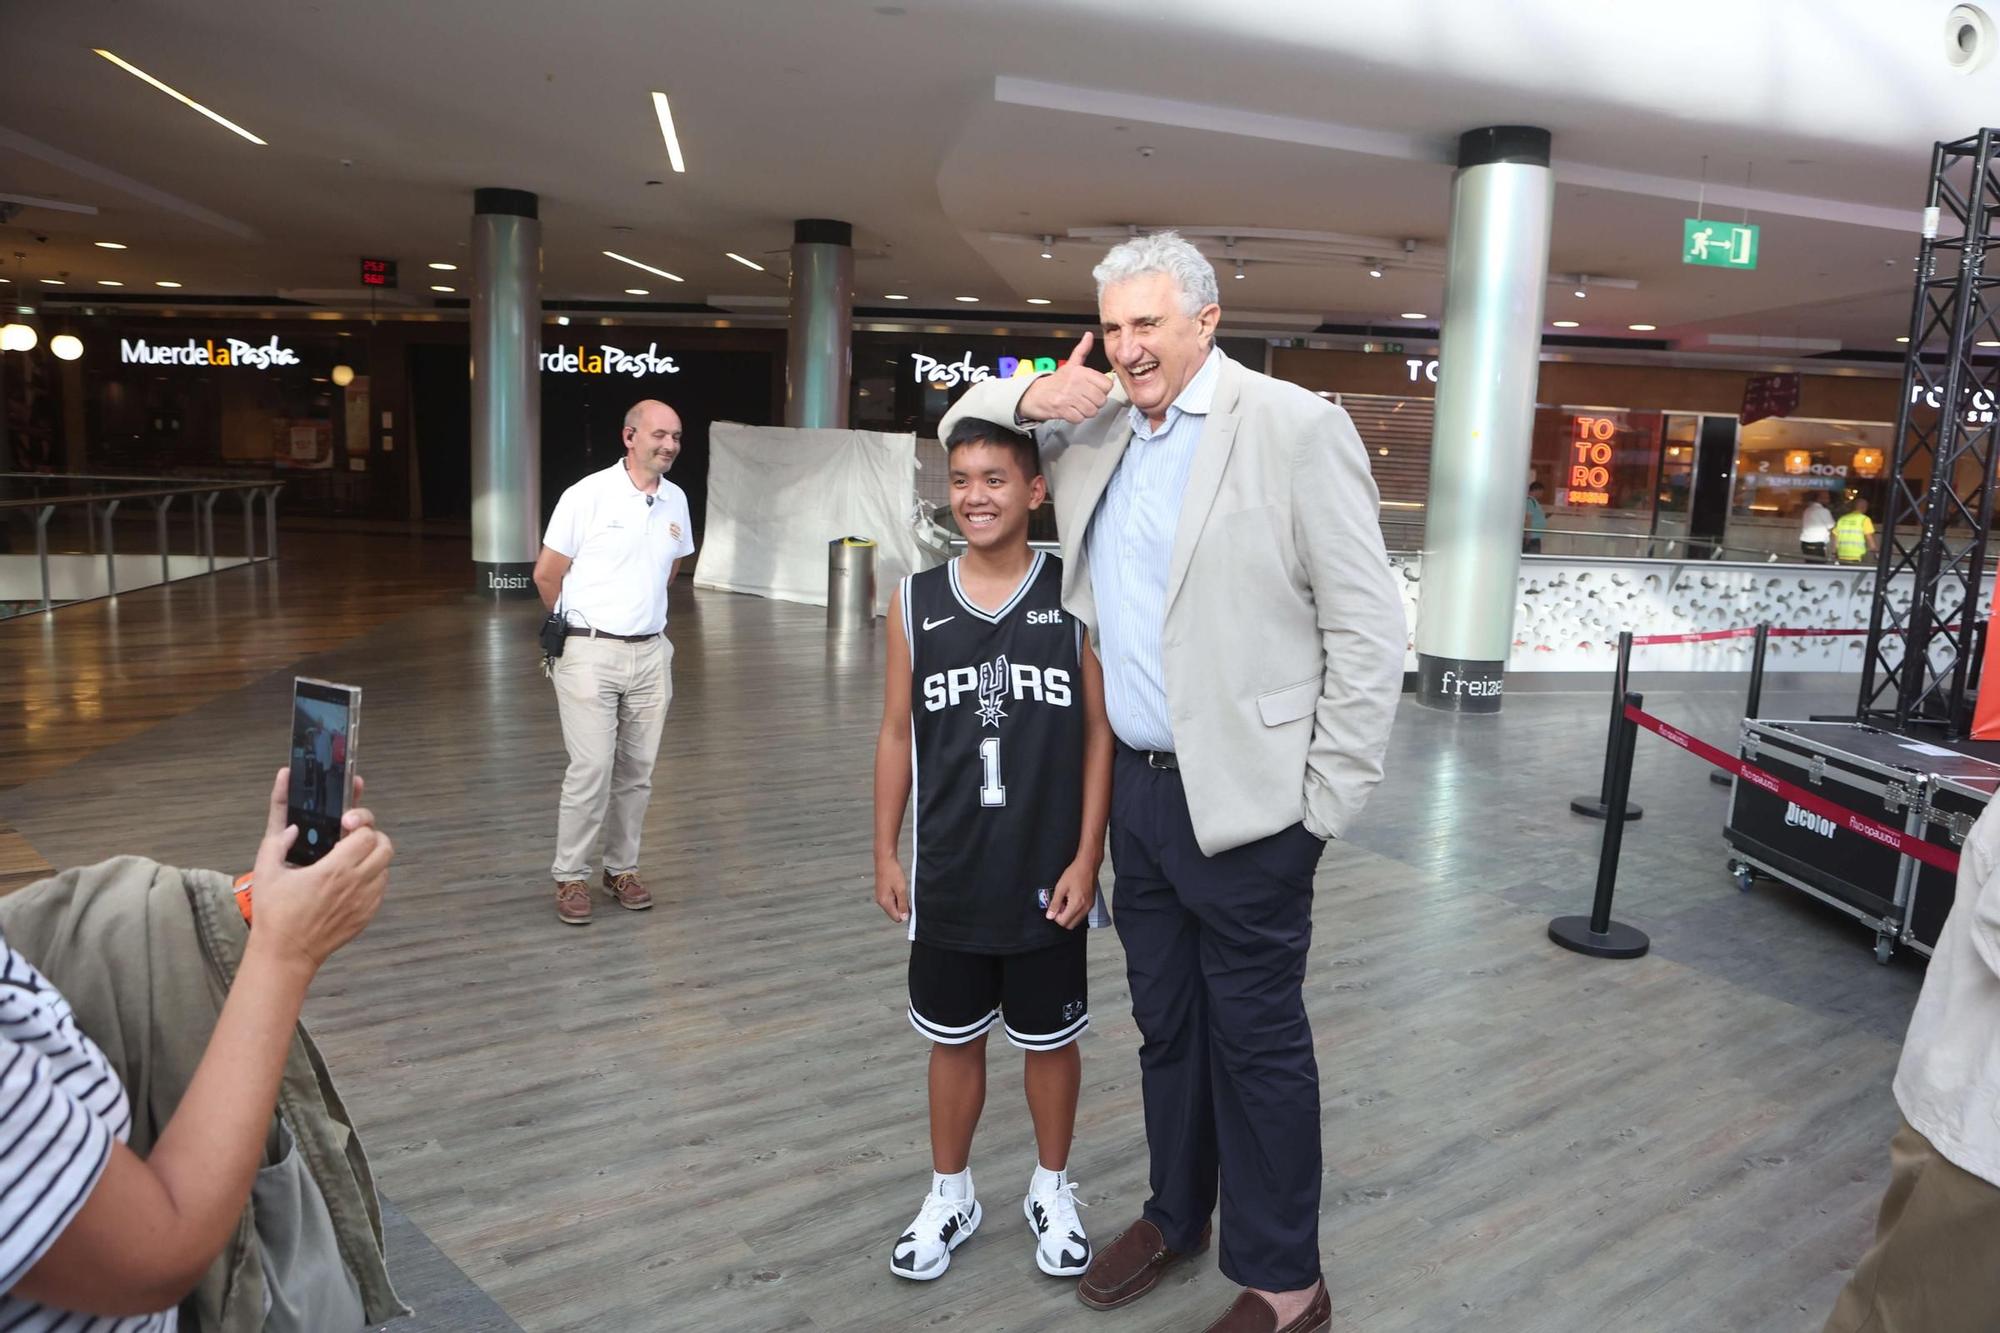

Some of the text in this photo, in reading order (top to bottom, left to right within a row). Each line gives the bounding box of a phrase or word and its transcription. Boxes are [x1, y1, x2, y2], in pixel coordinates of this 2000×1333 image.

[121, 335, 300, 369] MuerdelaPasta
[911, 351, 1068, 387] Pasta PAR
[1577, 417, 1615, 440] TO
[1575, 442, 1612, 465] TO
[1571, 465, 1609, 488] RO
[487, 571, 530, 589] loisir
[923, 655, 1072, 728] SPURS
[979, 737, 1007, 808] 1
